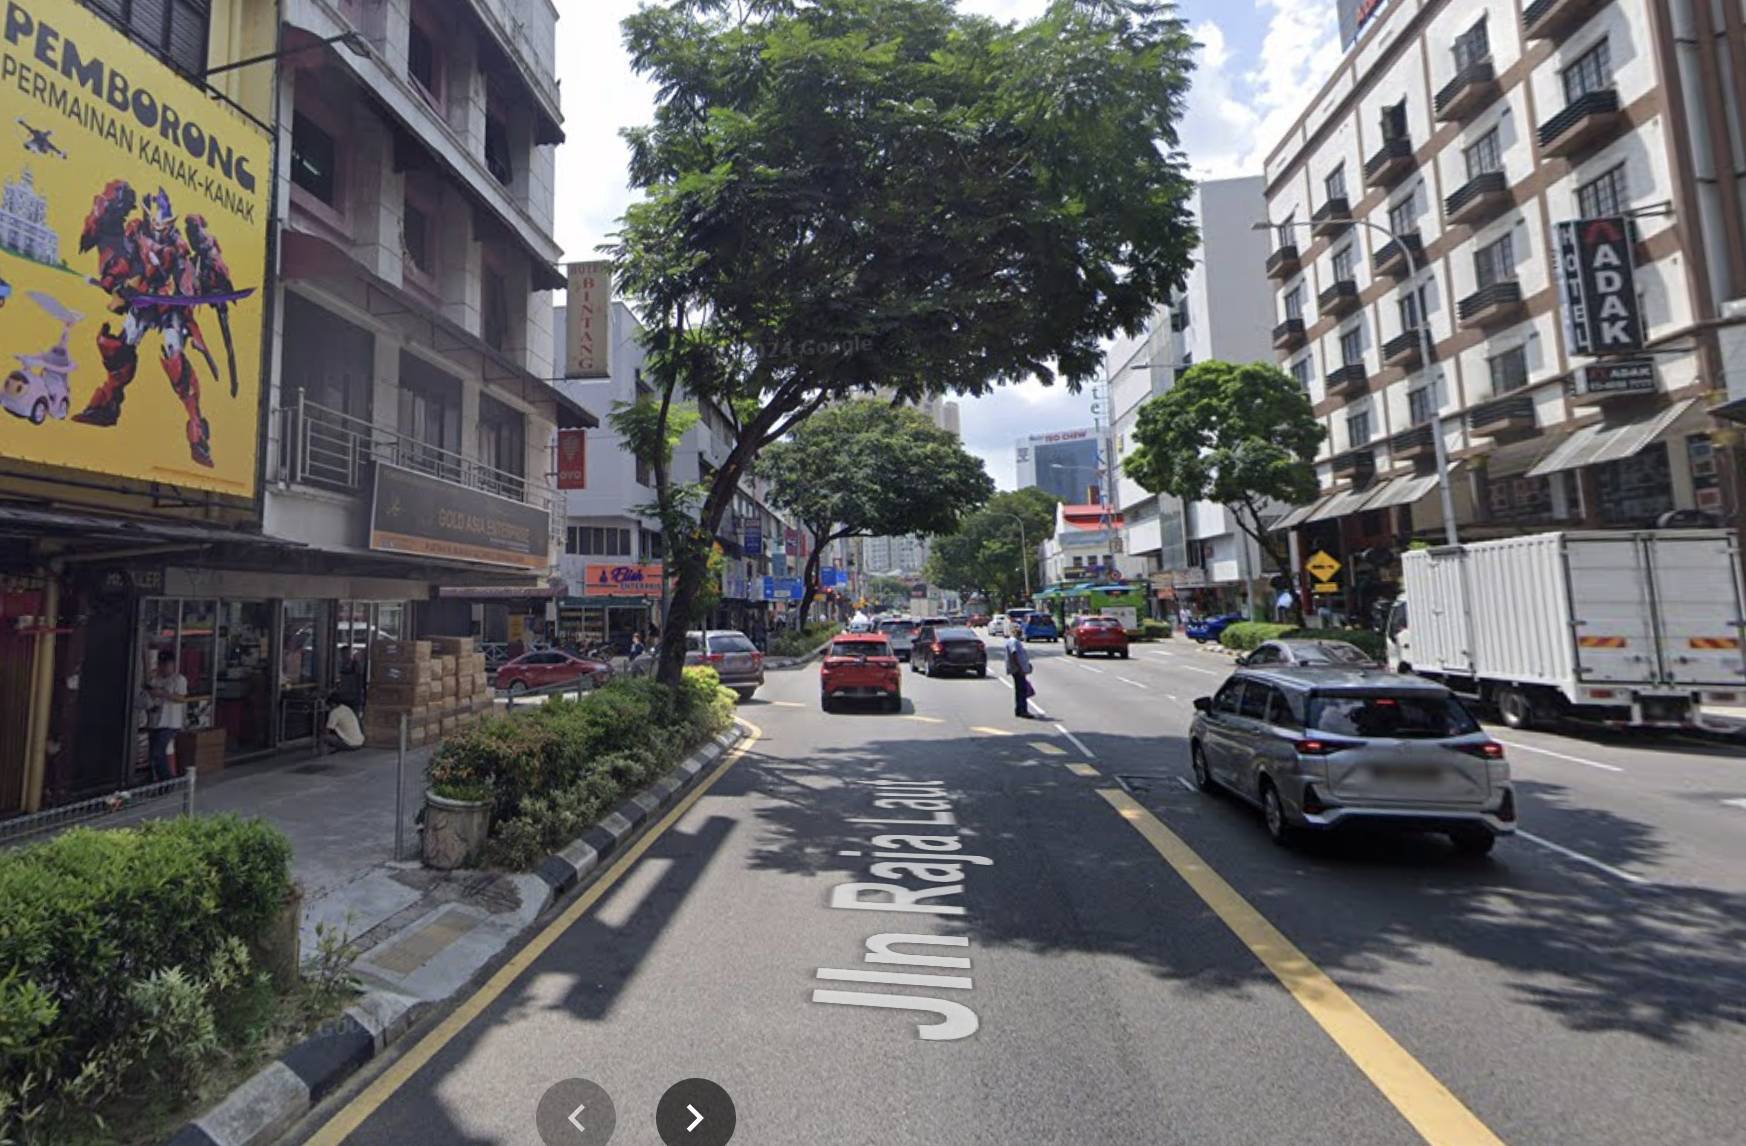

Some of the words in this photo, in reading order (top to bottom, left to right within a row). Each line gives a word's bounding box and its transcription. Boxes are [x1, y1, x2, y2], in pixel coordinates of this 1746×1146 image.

[2, 53, 134, 153] PERMAINAN
[139, 135, 255, 225] KANAK-KANAK
[4, 1, 256, 194] PEMBORONG
[578, 277, 595, 369] BINTANG
[1561, 227, 1590, 347] HOTEL
[1592, 243, 1632, 344] ADAK
[438, 508, 464, 530] GOLD
[620, 583, 662, 591] ENTERPRIS
